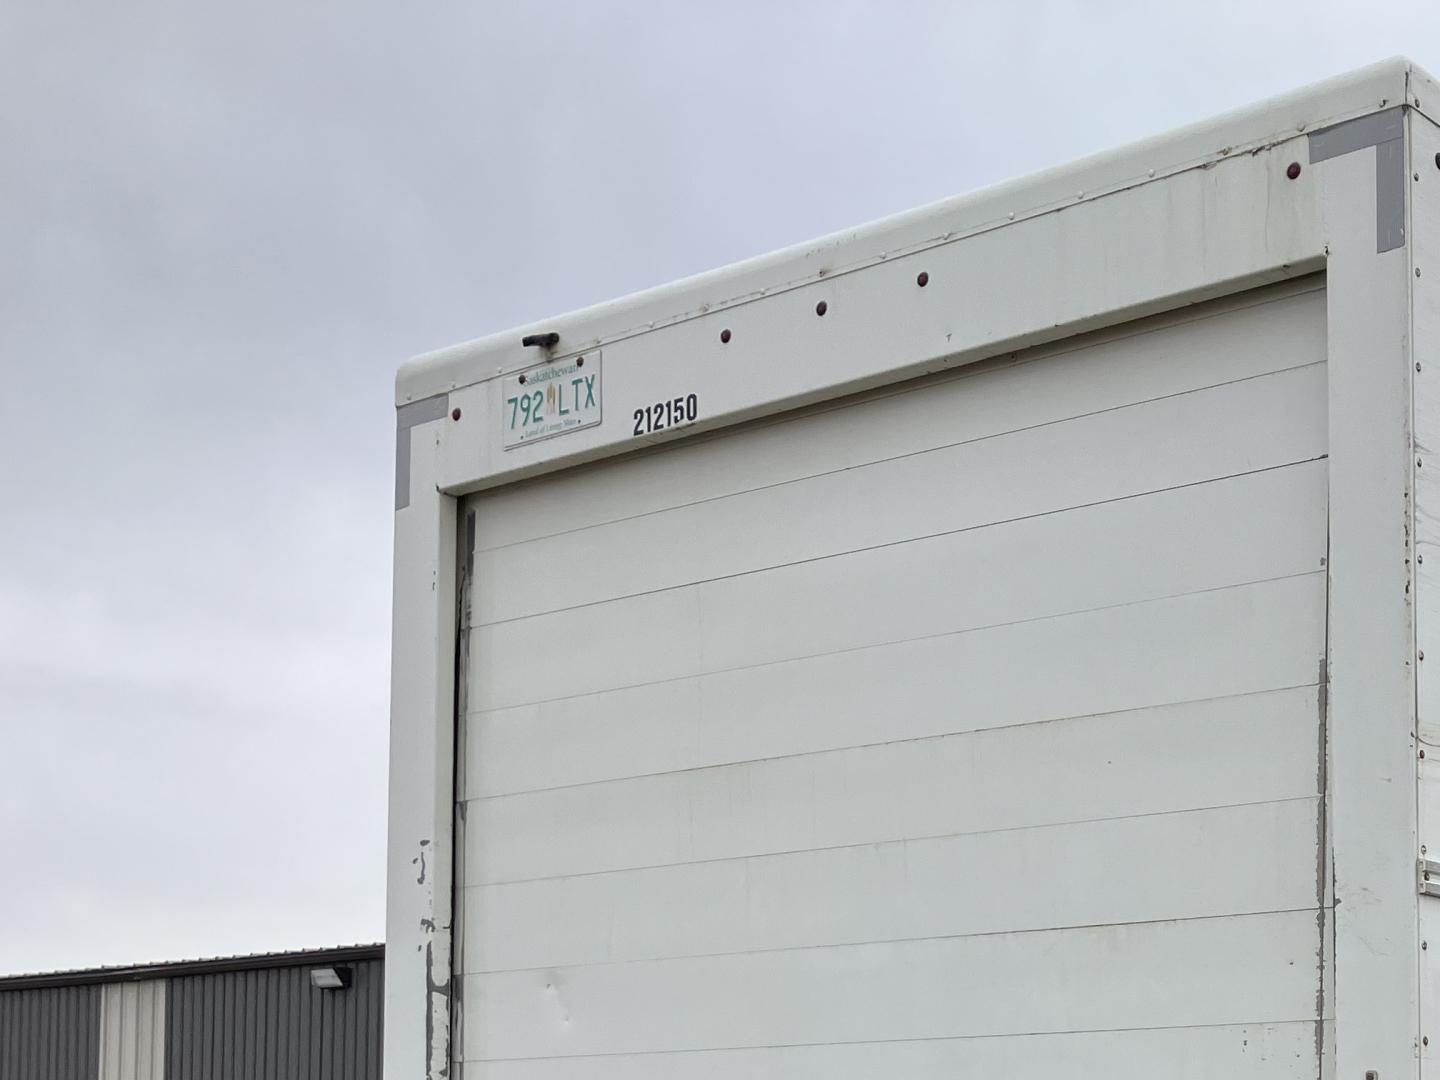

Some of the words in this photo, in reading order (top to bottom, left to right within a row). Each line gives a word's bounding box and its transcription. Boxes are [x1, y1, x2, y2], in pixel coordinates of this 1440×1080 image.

[507, 390, 544, 430] 792
[558, 374, 596, 416] LTX
[632, 393, 698, 437] 212150
